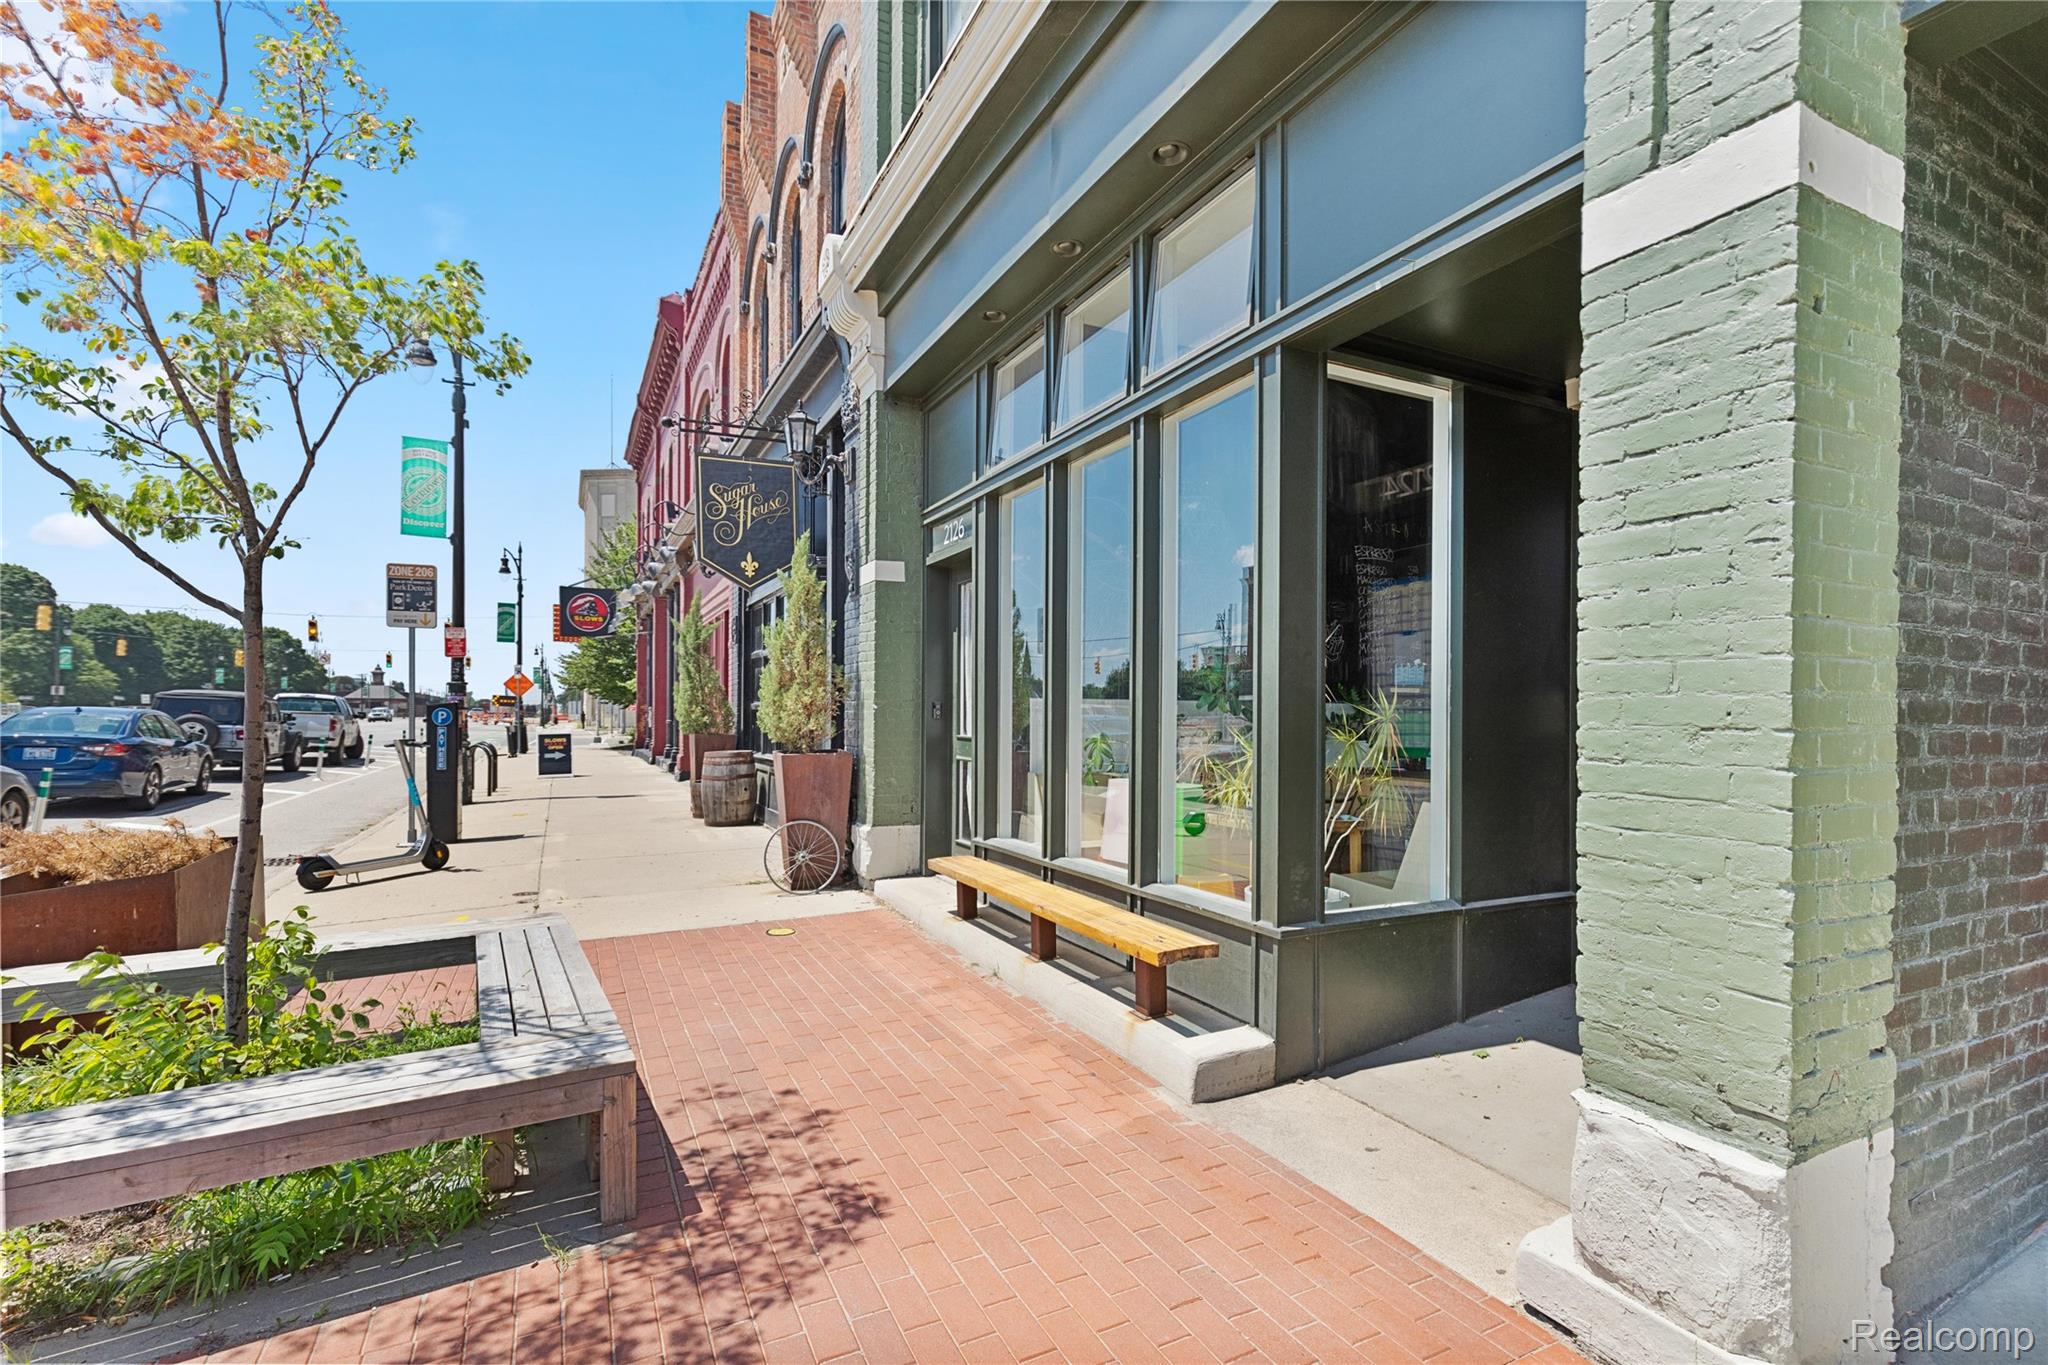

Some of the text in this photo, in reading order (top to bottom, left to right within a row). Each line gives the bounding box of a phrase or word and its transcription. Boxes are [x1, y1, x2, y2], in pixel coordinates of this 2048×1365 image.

[705, 476, 757, 520] Sugar
[402, 517, 446, 528] Discover
[714, 489, 790, 547] House
[943, 517, 965, 546] 2126
[388, 565, 434, 578] ZONE 206
[437, 710, 447, 724] P
